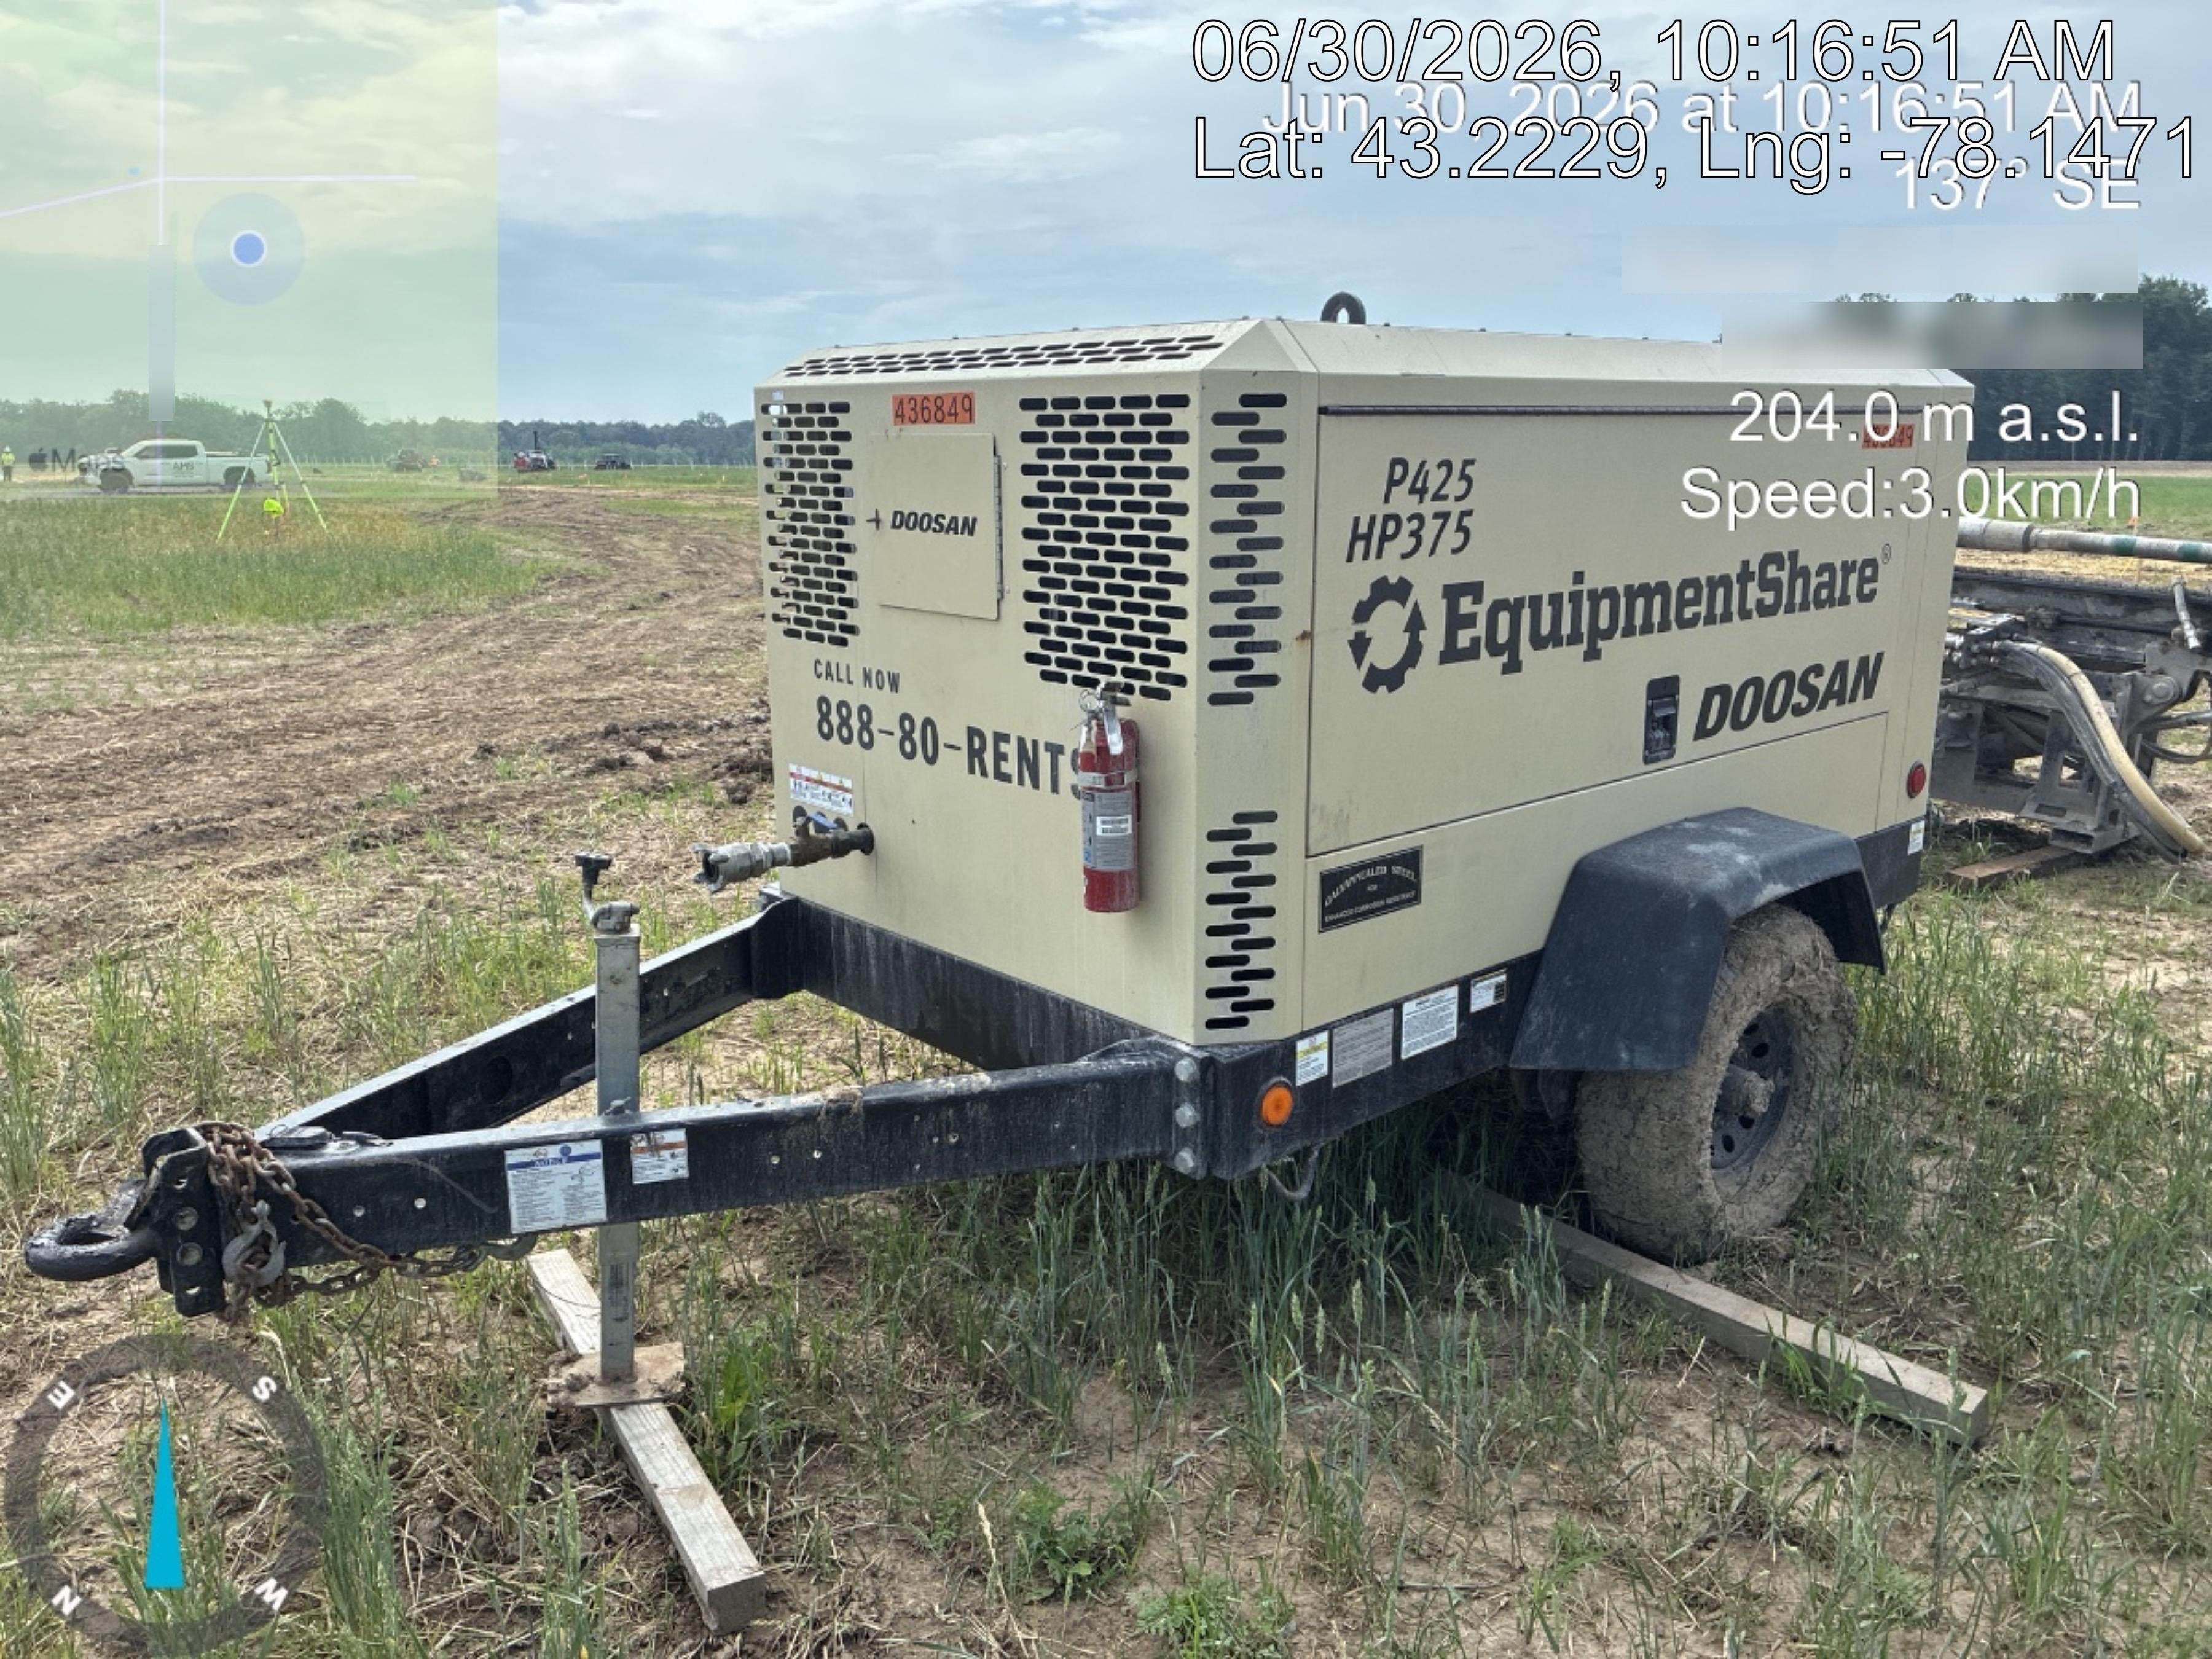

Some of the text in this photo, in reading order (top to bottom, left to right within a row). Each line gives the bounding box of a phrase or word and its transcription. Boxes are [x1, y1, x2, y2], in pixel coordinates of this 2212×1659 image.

[895, 394, 972, 424] 436849
[1383, 457, 1476, 503] P425
[890, 510, 977, 536] DOOSAN
[1346, 509, 1473, 562] HP375
[814, 659, 900, 693] CALL NOW
[1692, 651, 1885, 742] DOOSAN
